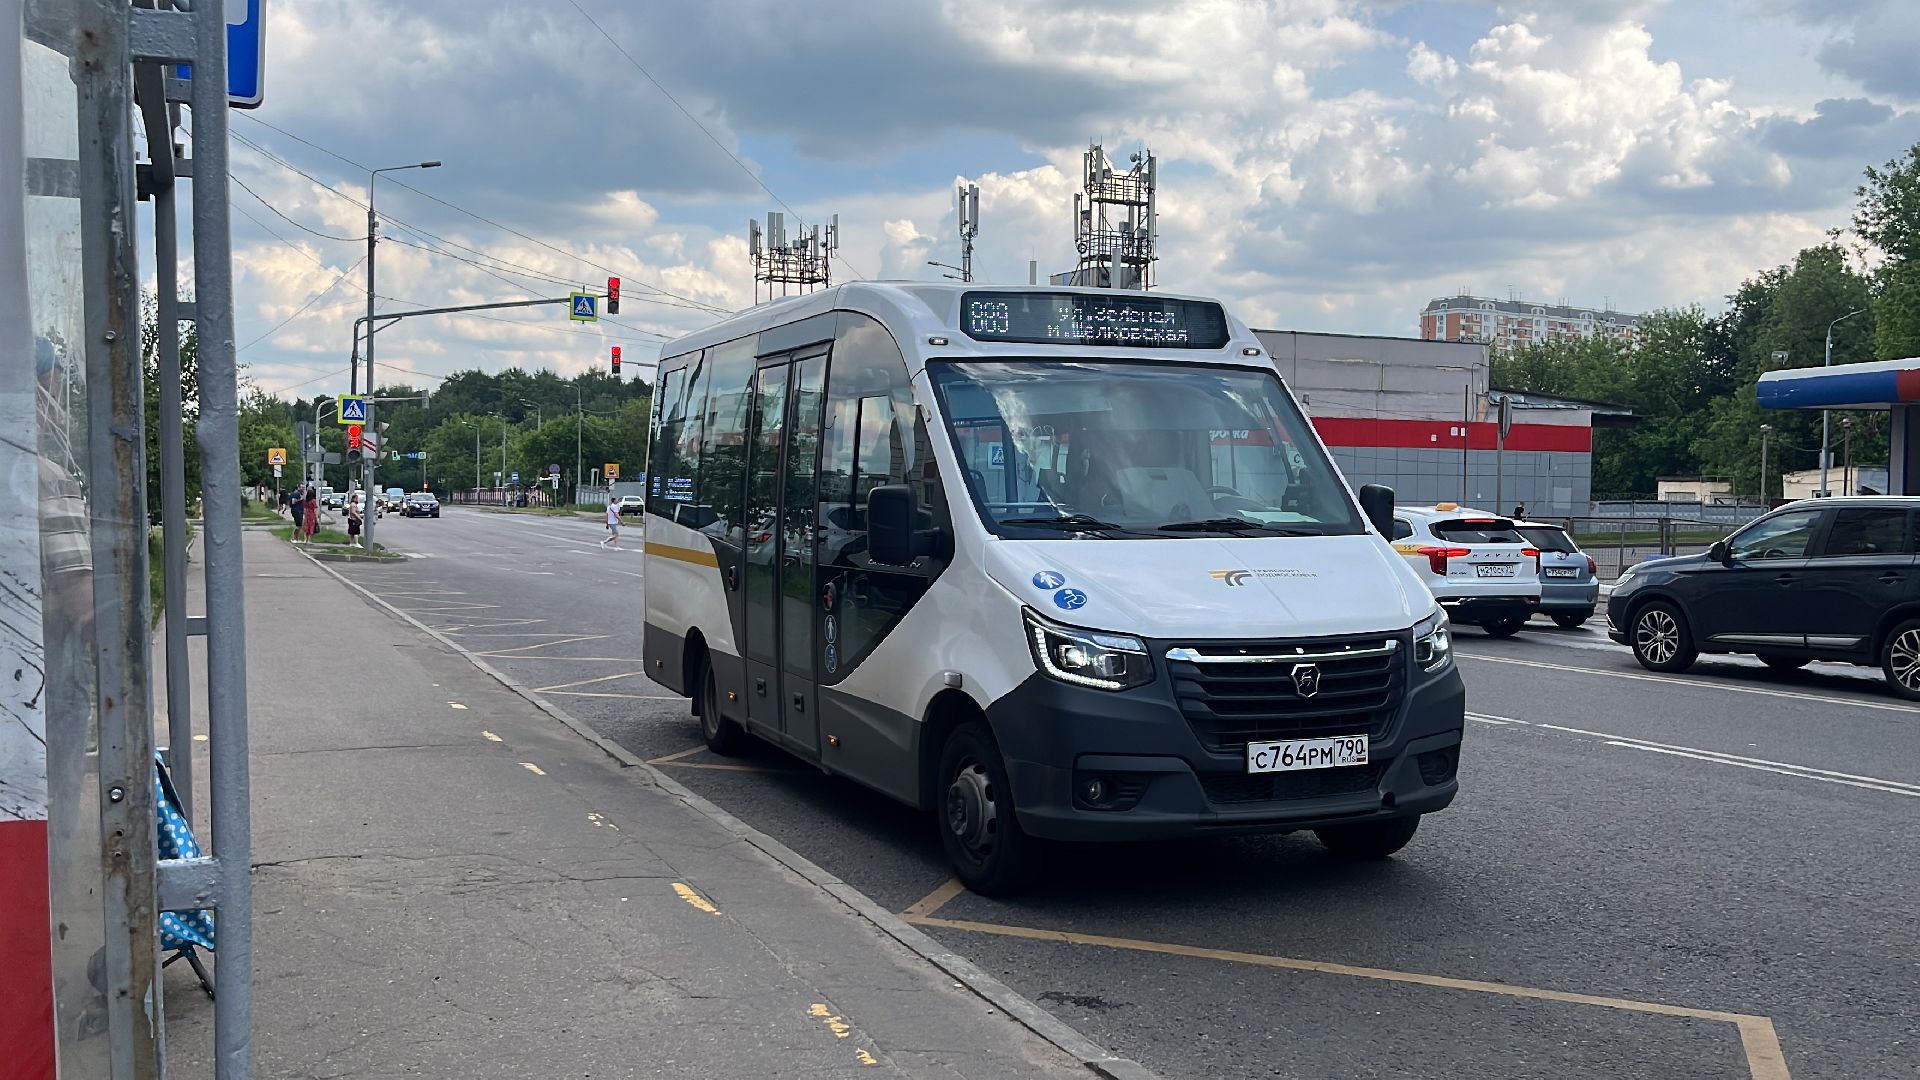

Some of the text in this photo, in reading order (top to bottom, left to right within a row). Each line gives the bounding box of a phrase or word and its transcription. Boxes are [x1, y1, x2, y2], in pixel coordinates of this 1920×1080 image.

[1255, 738, 1364, 769] С764РМ 790
[1341, 755, 1356, 764] RUS
